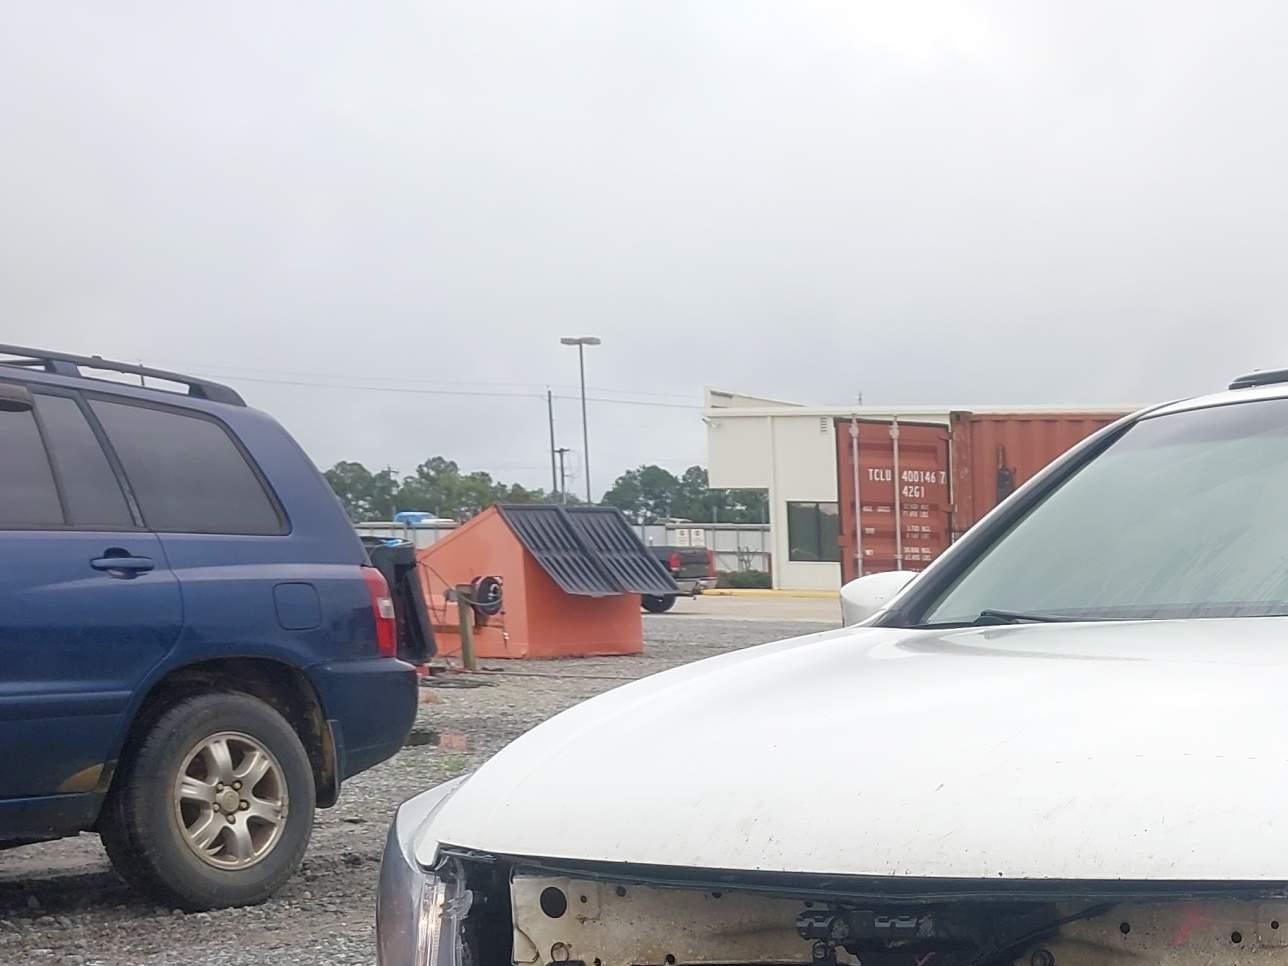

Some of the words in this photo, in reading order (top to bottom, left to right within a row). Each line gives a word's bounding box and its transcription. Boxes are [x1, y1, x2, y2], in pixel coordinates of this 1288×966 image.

[868, 468, 892, 481] TCLU
[901, 470, 937, 483] 400146
[902, 485, 925, 498] 42G1
